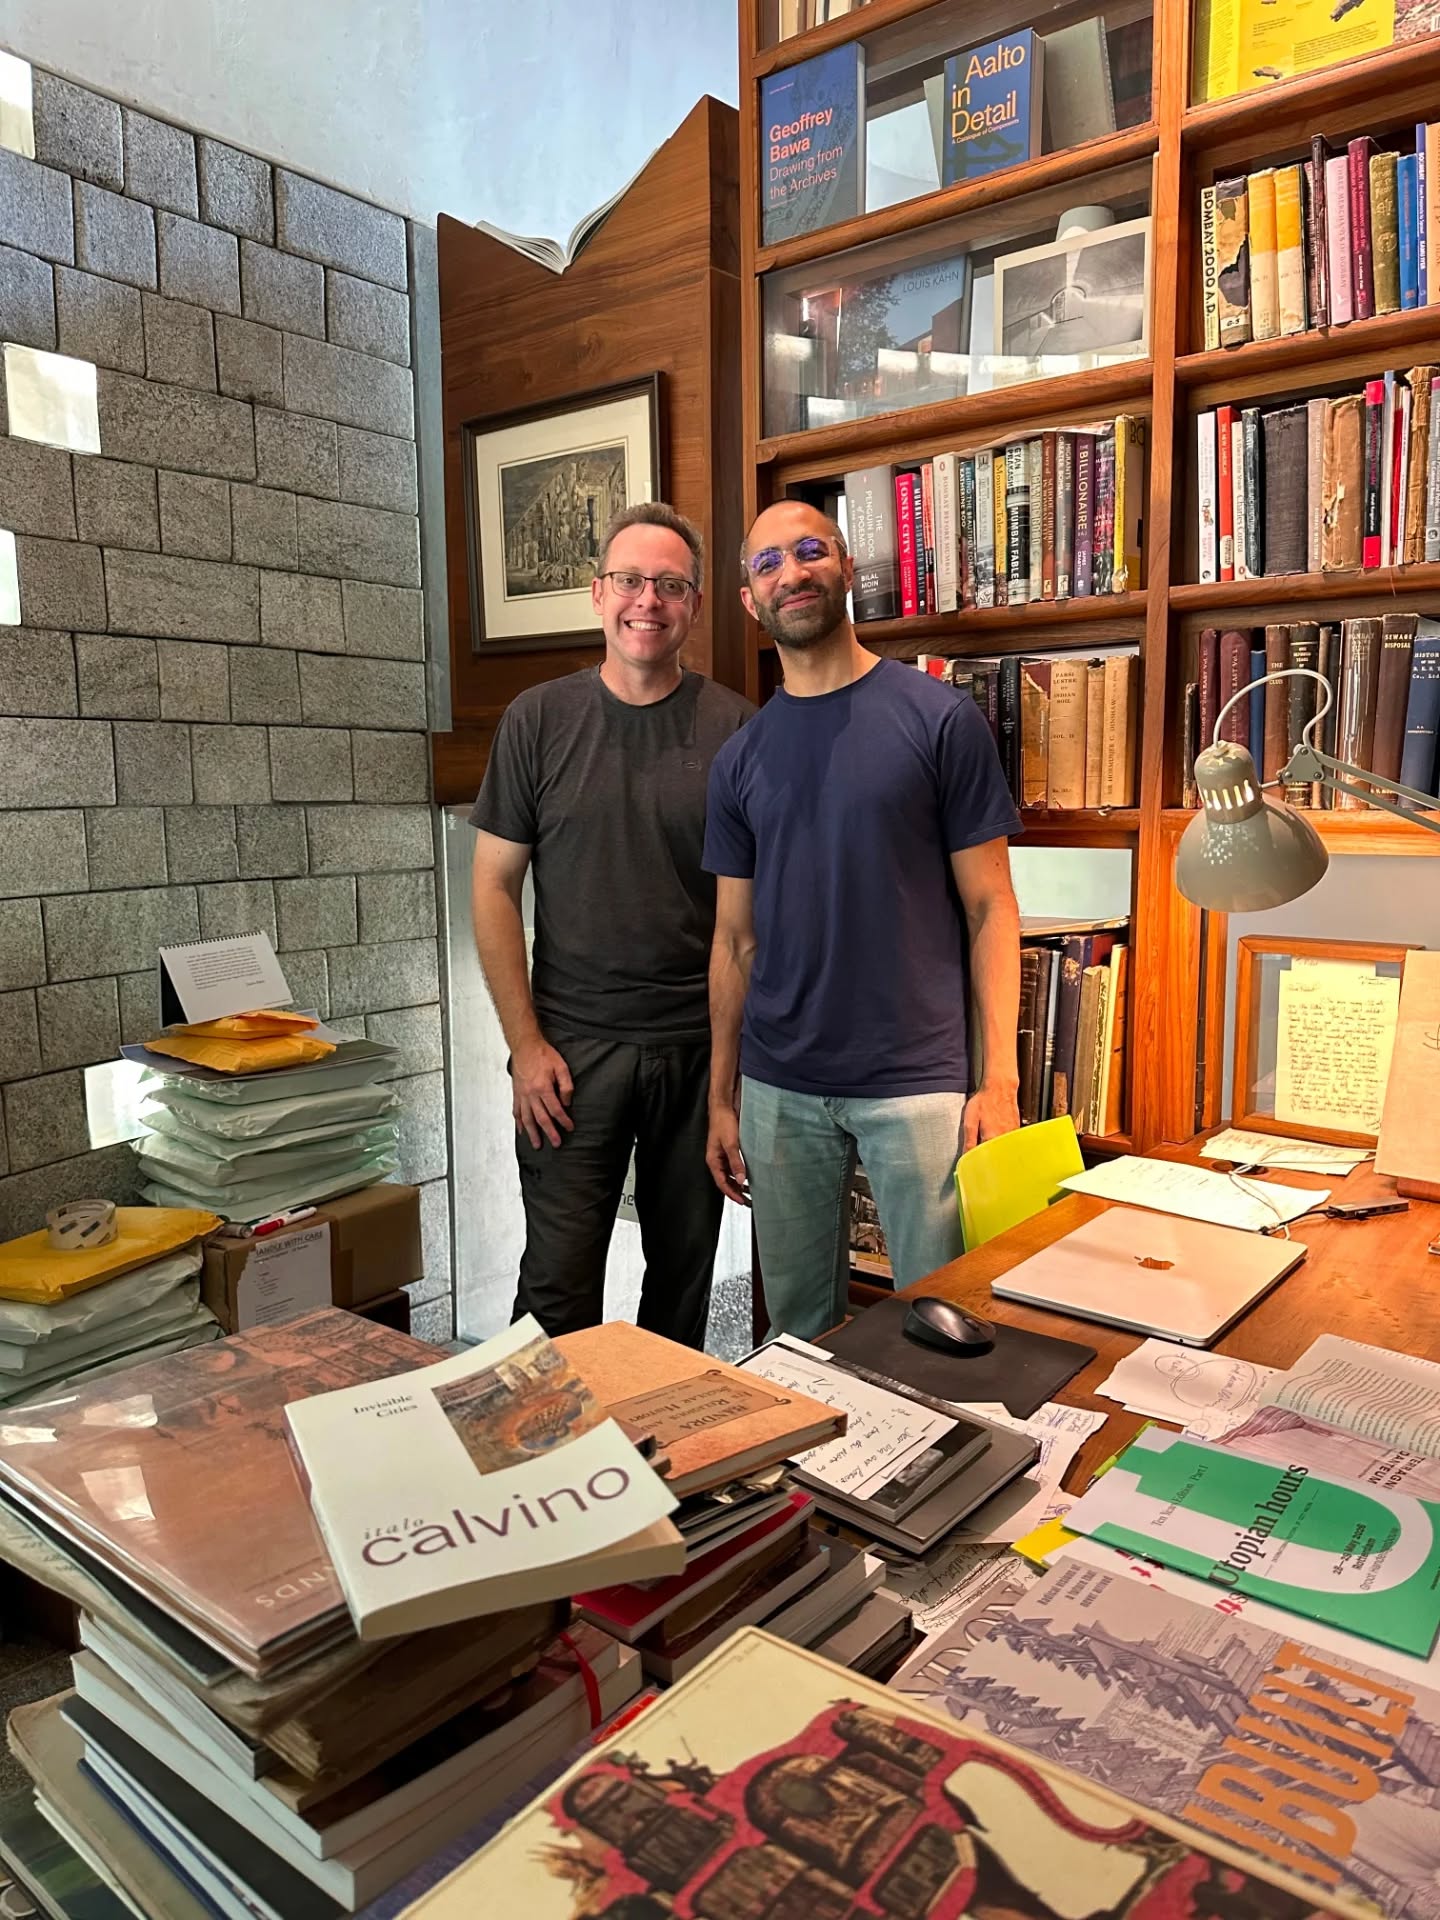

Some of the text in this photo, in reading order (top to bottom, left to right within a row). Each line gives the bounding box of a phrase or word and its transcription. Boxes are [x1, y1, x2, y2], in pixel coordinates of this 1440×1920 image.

[964, 44, 1026, 84] Aalto
[952, 84, 971, 109] in
[769, 108, 833, 142] Geoffrey
[952, 90, 1017, 138] Detail
[769, 146, 843, 181] Drawing from
[770, 137, 811, 163] Bawa
[770, 168, 838, 200] the Archives
[1203, 190, 1214, 245] BOMBAY
[903, 271, 959, 293] LOUIS KAHN
[1204, 246, 1215, 288] 2000
[1014, 448, 1022, 469] GYAN
[996, 464, 1004, 508] Mountain
[1065, 482, 1071, 491] IN
[1077, 451, 1088, 531] BILLIONAIRE
[900, 487, 911, 555] ONLY CITY
[914, 488, 922, 520] MUMBAI
[1236, 495, 1244, 523] Charles
[858, 516, 866, 548] POEMS
[865, 490, 875, 560] PENGUIN BOOK
[1237, 526, 1245, 553] Correa
[1010, 507, 1019, 585] MUMBAI FABLES
[860, 573, 879, 582] BILAL
[861, 580, 879, 590] MOIN
[284, 1236, 303, 1248] WITH
[304, 1231, 323, 1241] CARE
[353, 1393, 414, 1415] Invisible
[376, 1404, 418, 1418] Cities
[1367, 1450, 1411, 1485] DANTEUM
[1382, 1455, 1426, 1490] TERRAGNI
[1151, 1516, 1163, 1527] Ten
[1174, 1482, 1195, 1505] Edition
[1190, 1467, 1205, 1481] Part
[361, 1466, 630, 1567] calvino
[363, 1516, 424, 1540] italo
[1208, 1515, 1278, 1586] Utopian
[1254, 1464, 1309, 1516] hours
[255, 1565, 334, 1608] NDS
